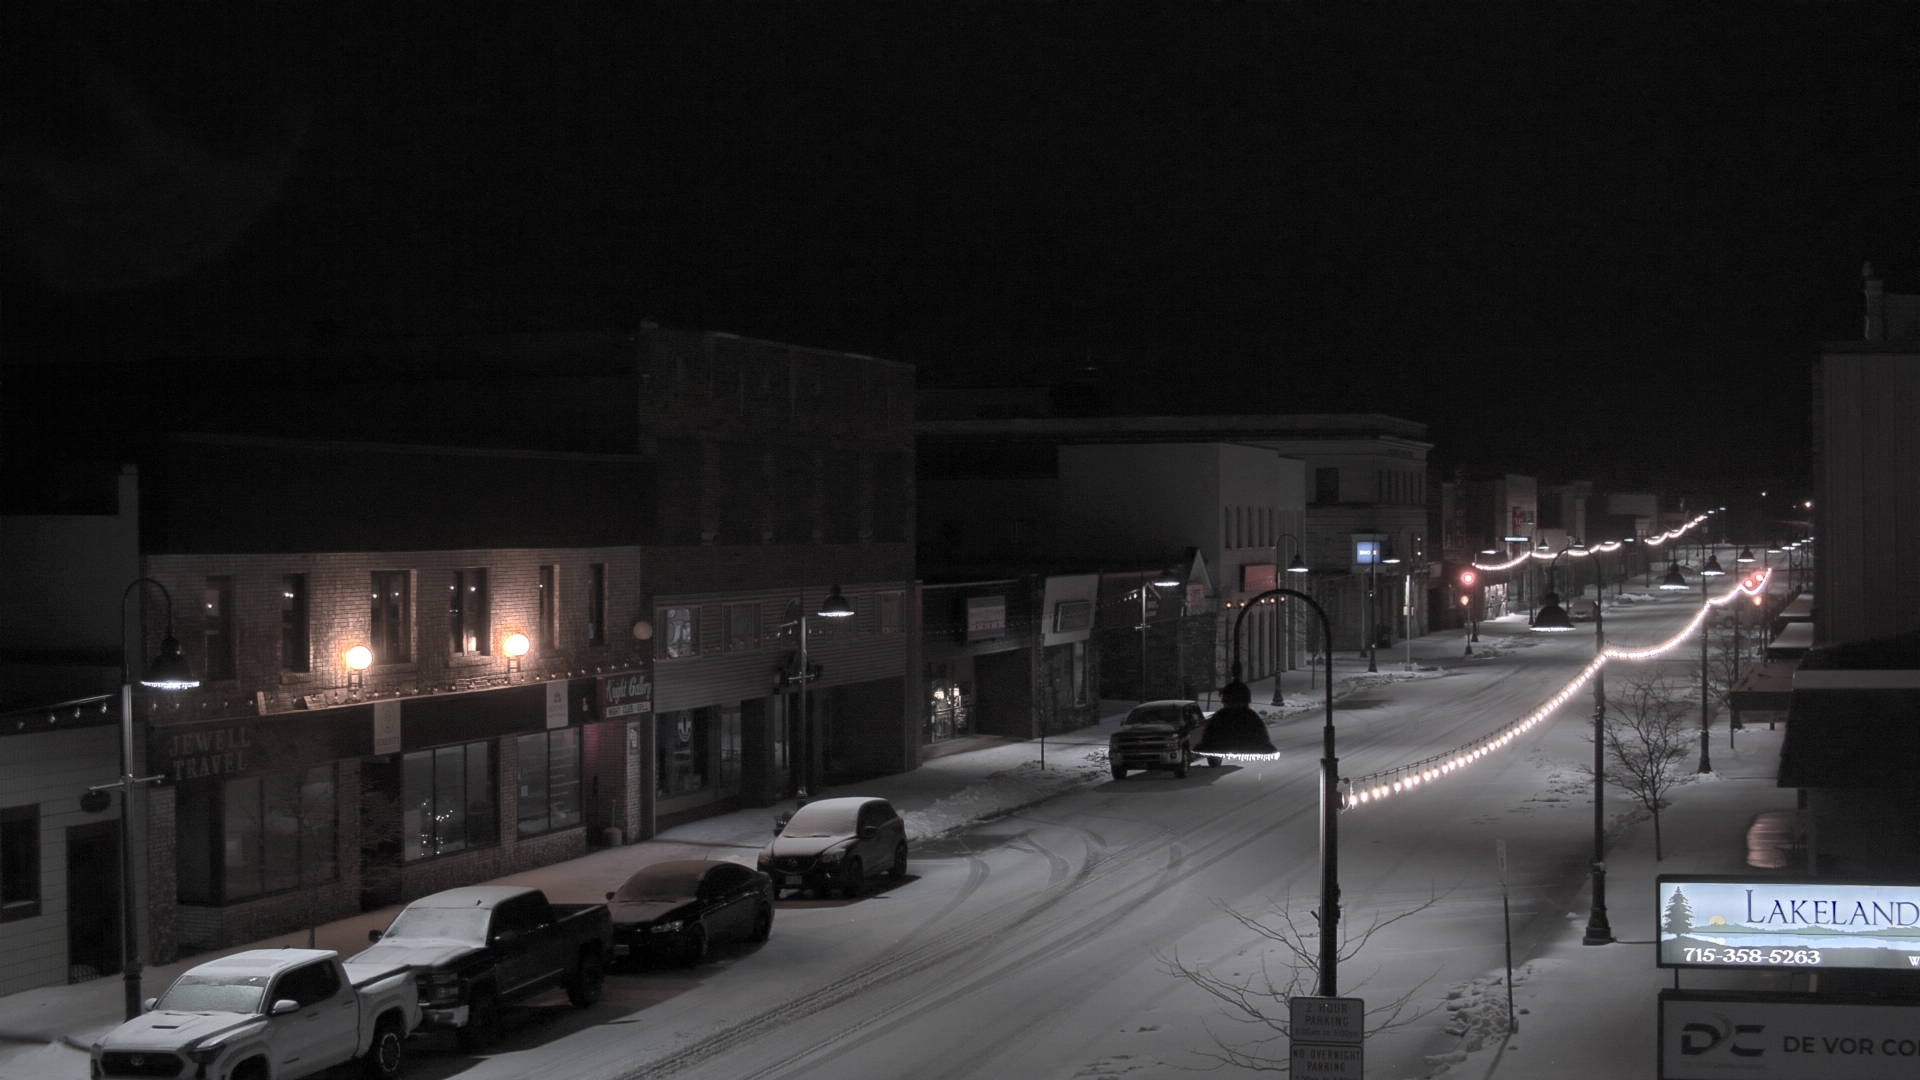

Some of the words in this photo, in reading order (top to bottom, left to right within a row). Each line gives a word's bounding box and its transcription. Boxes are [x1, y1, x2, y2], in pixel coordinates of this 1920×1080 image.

[606, 678, 628, 704] Knight
[628, 676, 652, 700] Gallery
[608, 707, 620, 716] NIGHT
[622, 705, 634, 714] CLUB
[637, 703, 649, 712] GRILL
[170, 726, 251, 756] JEWELL
[172, 751, 248, 780] TRAVEL
[1745, 889, 1920, 926] LAKELAND
[1683, 948, 1821, 965] 715-358-5263
[1306, 1002, 1313, 1013] 2
[1319, 1003, 1348, 1014] HOUR
[1305, 1015, 1350, 1026] PARKING
[1293, 1048, 1304, 1059] NO
[1310, 1049, 1360, 1060] OVERNIGHT
[1782, 1036, 1815, 1053] DE
[1822, 1037, 1874, 1056] VOR
[1881, 1038, 1920, 1056] CO
[1308, 1061, 1346, 1072] PARKING
